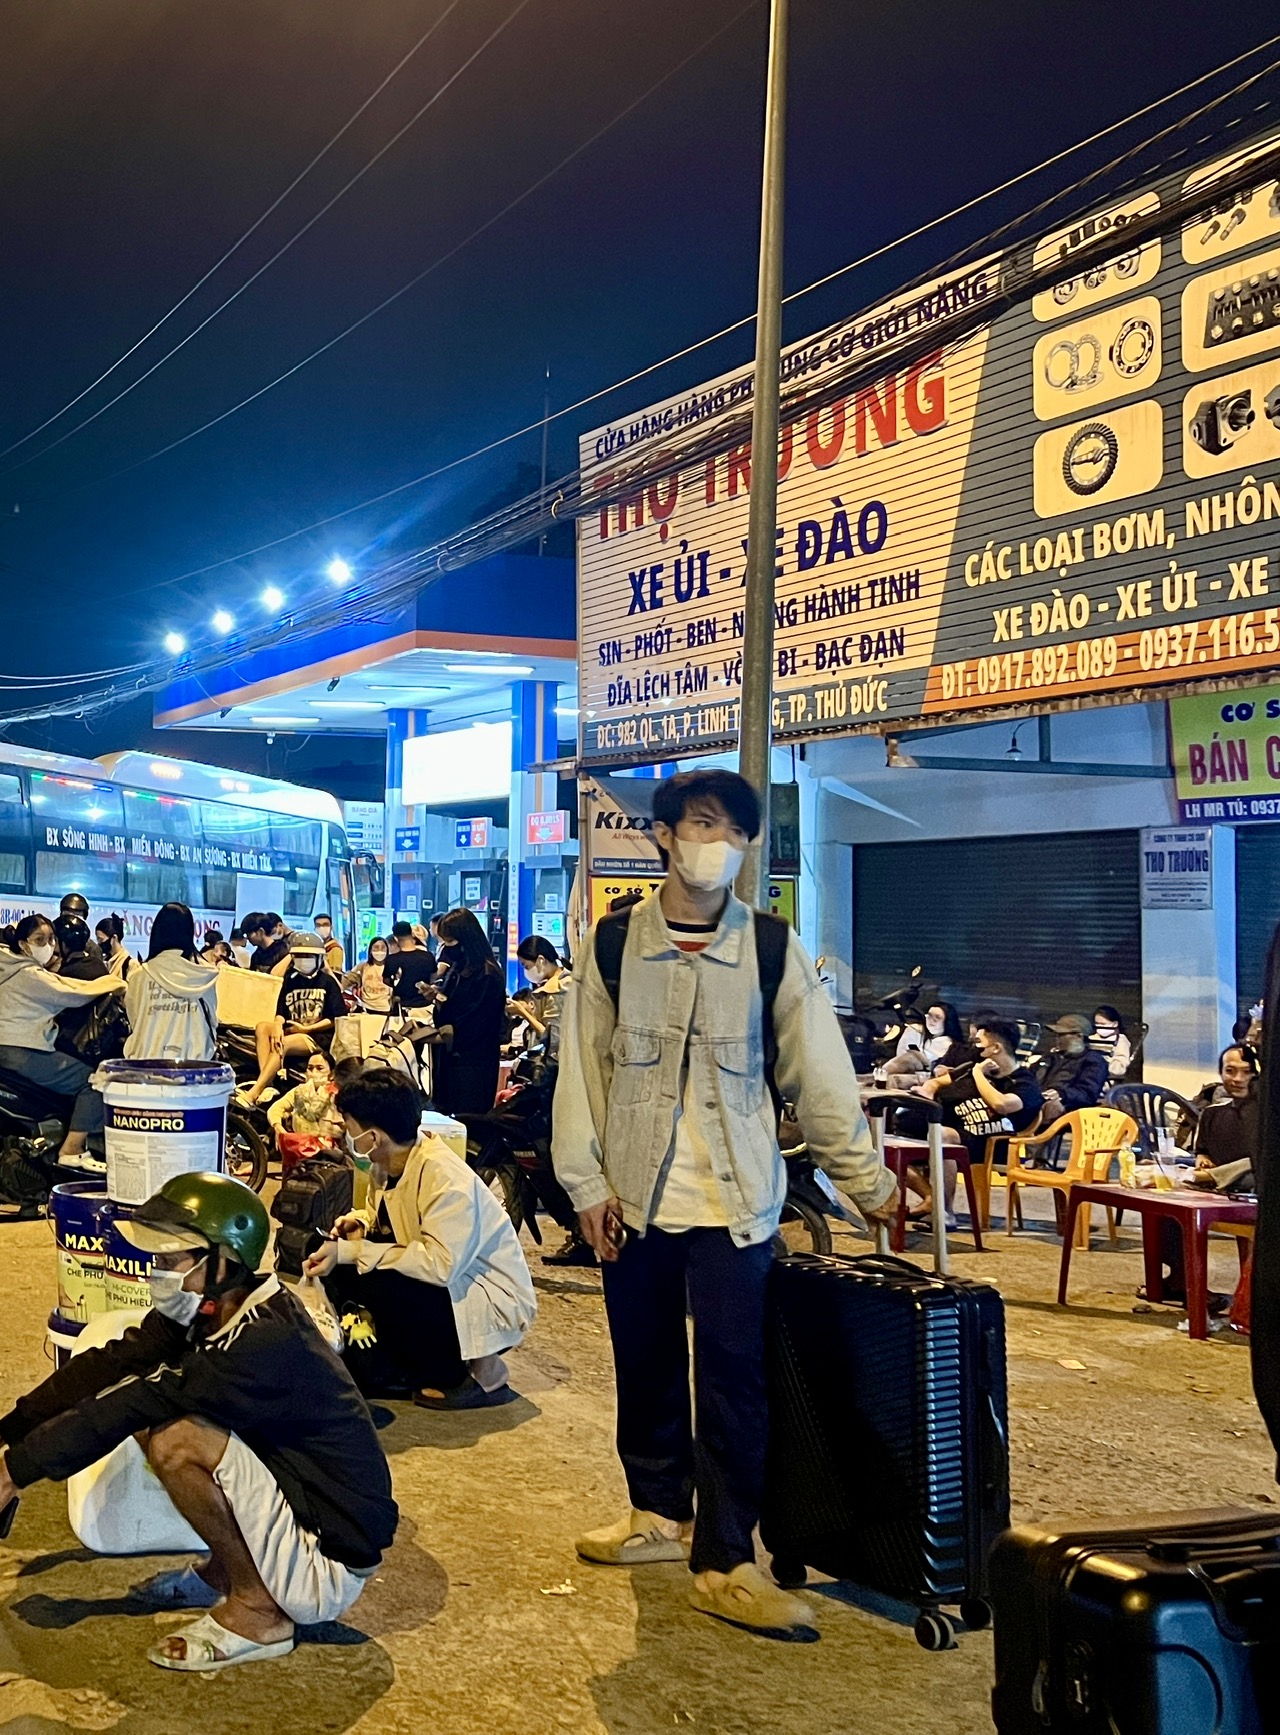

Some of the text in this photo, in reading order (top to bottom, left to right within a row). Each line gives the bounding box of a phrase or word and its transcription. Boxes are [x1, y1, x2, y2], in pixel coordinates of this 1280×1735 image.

[627, 563, 665, 615] XE
[674, 539, 711, 603] ỦI
[795, 496, 888, 572] ĐÀO
[965, 541, 1012, 587] CÁC
[1020, 528, 1085, 577] LOẠI
[1093, 509, 1176, 559] BƠM,
[599, 640, 621, 666] SIN
[634, 618, 672, 660] PHỐT
[687, 618, 717, 648] BEN
[805, 584, 860, 623] HÀNH
[868, 569, 920, 609] TINH
[992, 556, 1269, 643] XE ĐÀO XE ỦI XE
[637, 670, 669, 706] LỆCH
[675, 662, 708, 695] TÂM
[778, 650, 797, 677] BI
[816, 637, 853, 675] BẠC
[860, 628, 905, 668] ĐẠN
[941, 608, 1280, 700] ĐT: 0917.892.089 0937.116.5
[618, 720, 637, 746] 982
[640, 718, 660, 748] QL.
[663, 715, 681, 743] 1A,
[684, 712, 695, 737] P.
[698, 705, 729, 735] LINH
[815, 683, 846, 719] THỦ
[851, 677, 888, 714] ĐỨC
[1221, 702, 1255, 722] CƠ
[1189, 732, 1249, 785] BÁN
[595, 811, 653, 830] Kixx
[1185, 799, 1280, 818] LH MR TÚ: 0937
[46, 827, 59, 846] BX
[62, 826, 86, 850] SÔNG
[88, 833, 108, 851] HINH
[114, 837, 125, 854] BX
[132, 834, 151, 857] MIỀN
[154, 839, 175, 860] ĐÔNG
[180, 845, 191, 862] BX
[192, 847, 202, 863] AN
[204, 846, 227, 867] SƯƠNG
[231, 850, 241, 868] BX
[605, 886, 621, 895] CƠ
[627, 884, 644, 895] SỞ
[113, 1114, 185, 1131] NANOPRO
[67, 1267, 82, 1278] CHE
